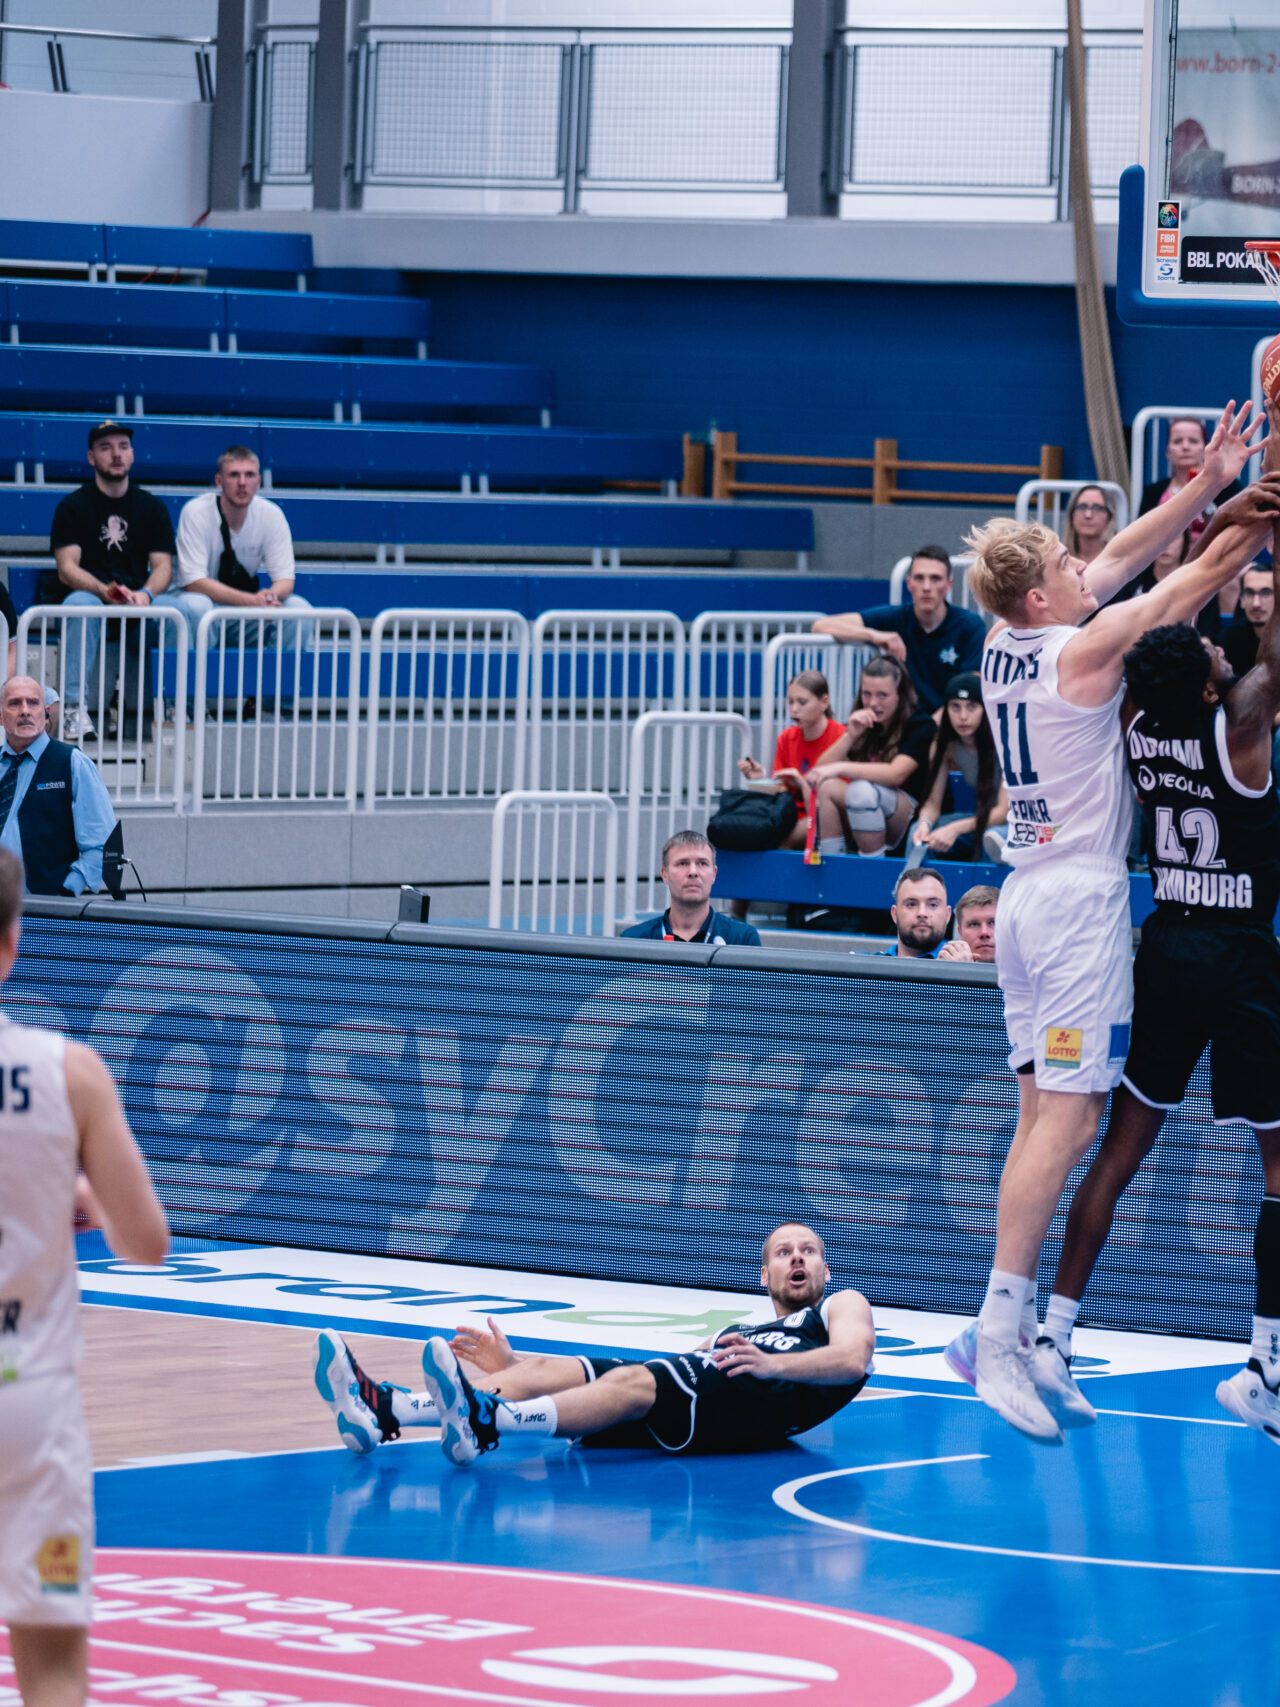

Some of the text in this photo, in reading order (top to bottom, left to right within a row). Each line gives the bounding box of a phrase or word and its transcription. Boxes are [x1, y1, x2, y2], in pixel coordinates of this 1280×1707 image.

[1187, 251, 1214, 268] BBL
[997, 702, 1039, 787] 11
[1158, 772, 1215, 800] VEOLIA
[1155, 805, 1227, 869] 42
[1047, 1045, 1078, 1057] LOTTO
